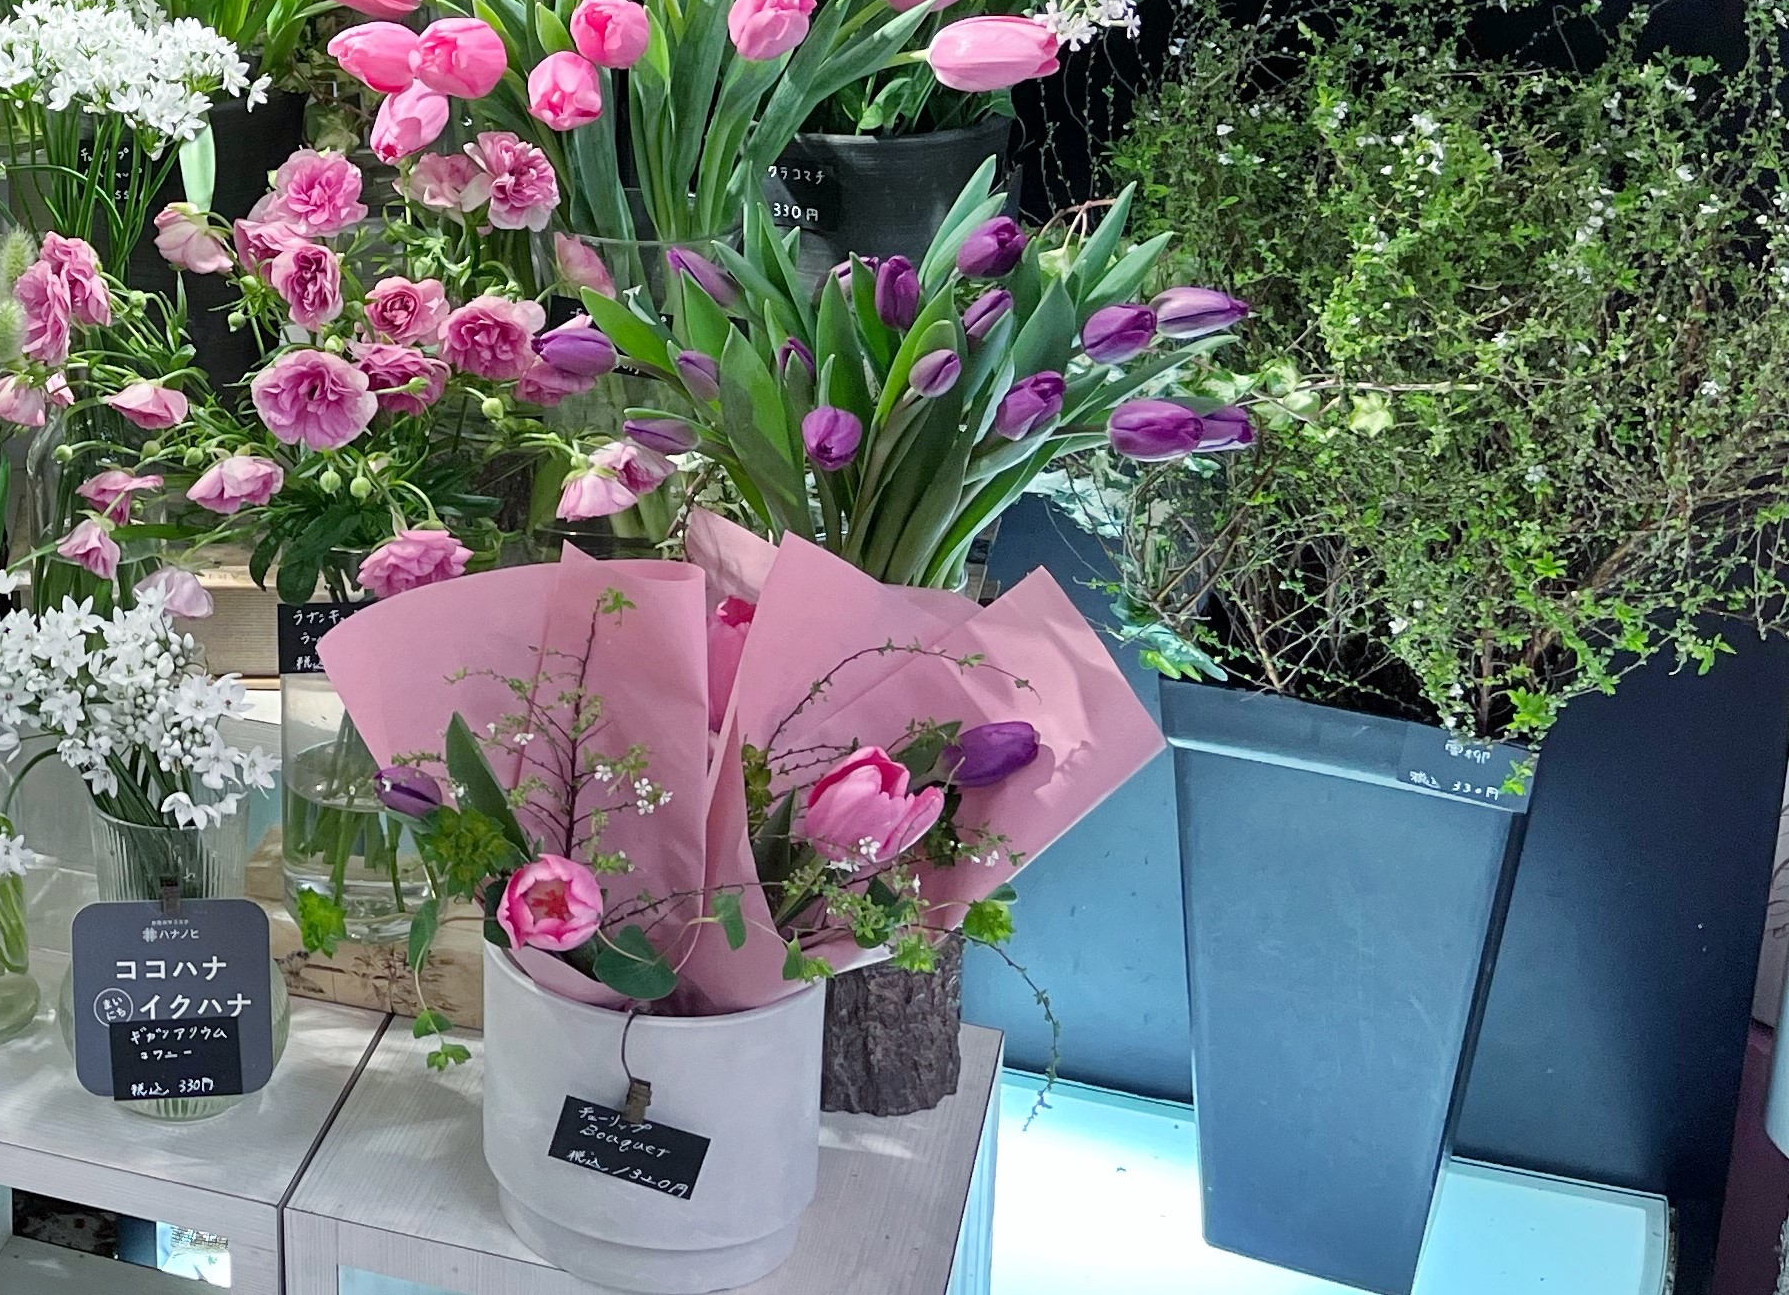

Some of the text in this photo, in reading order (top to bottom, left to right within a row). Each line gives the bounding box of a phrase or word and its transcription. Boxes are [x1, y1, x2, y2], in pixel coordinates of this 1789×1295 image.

[767, 165, 826, 185] クラコマチ
[773, 202, 819, 222] 330円
[1452, 780, 1499, 801] 330円
[159, 929, 200, 940] ハナノヒ
[115, 955, 228, 981] ココハナ
[102, 996, 123, 1011] まい
[139, 992, 253, 1020] イクハナ
[105, 1009, 127, 1022] にち
[130, 1077, 214, 1097] 税込 330円
[578, 1106, 653, 1134] チューリップ
[611, 1166, 689, 1199] 1320円
